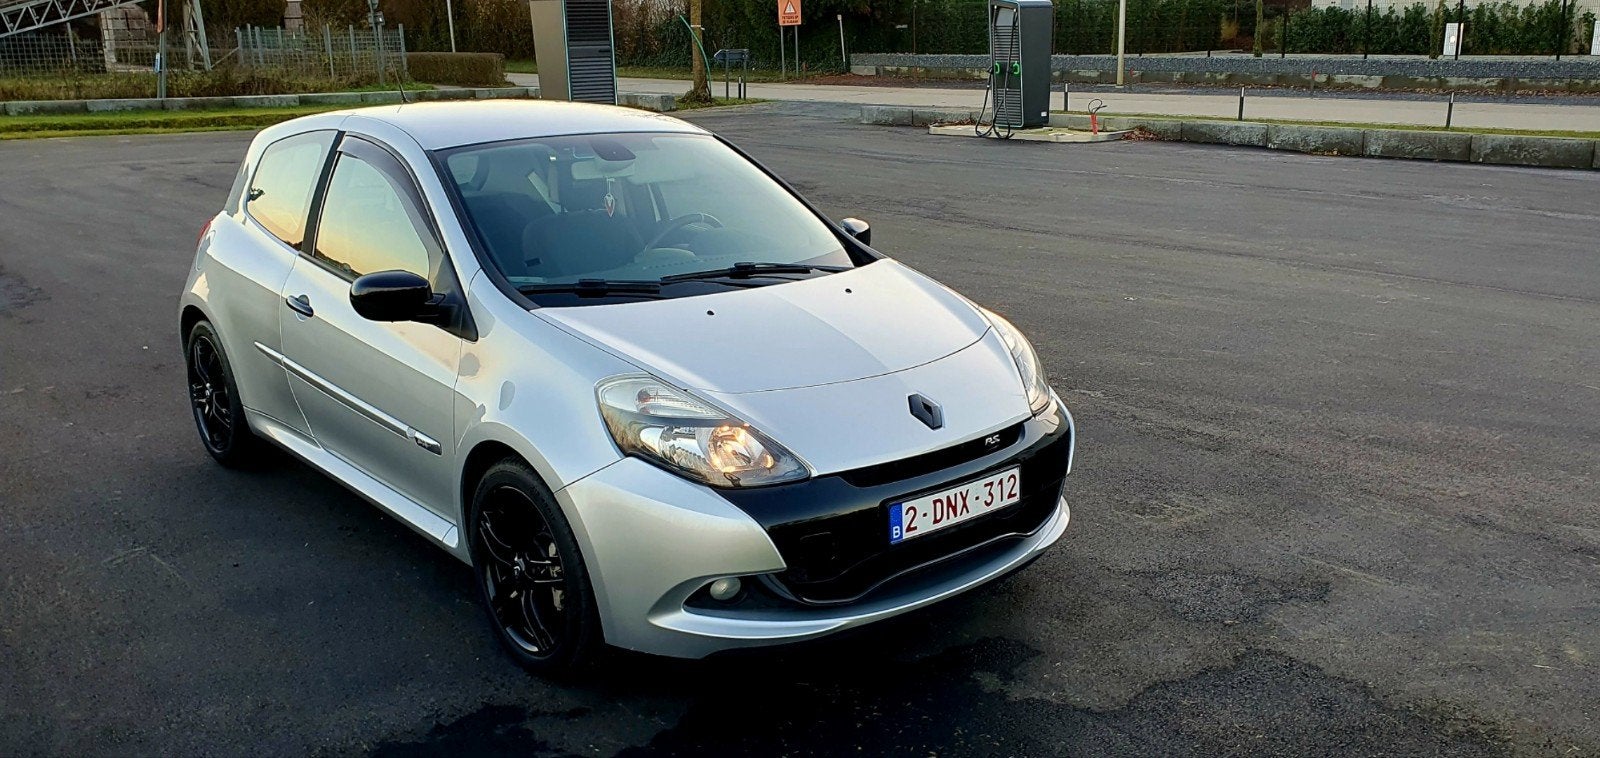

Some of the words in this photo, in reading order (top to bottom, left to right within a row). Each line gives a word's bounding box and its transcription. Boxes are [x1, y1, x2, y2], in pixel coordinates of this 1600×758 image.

[985, 434, 1000, 445] RS
[905, 474, 1017, 533] 2-DNX-312
[892, 526, 901, 538] B
